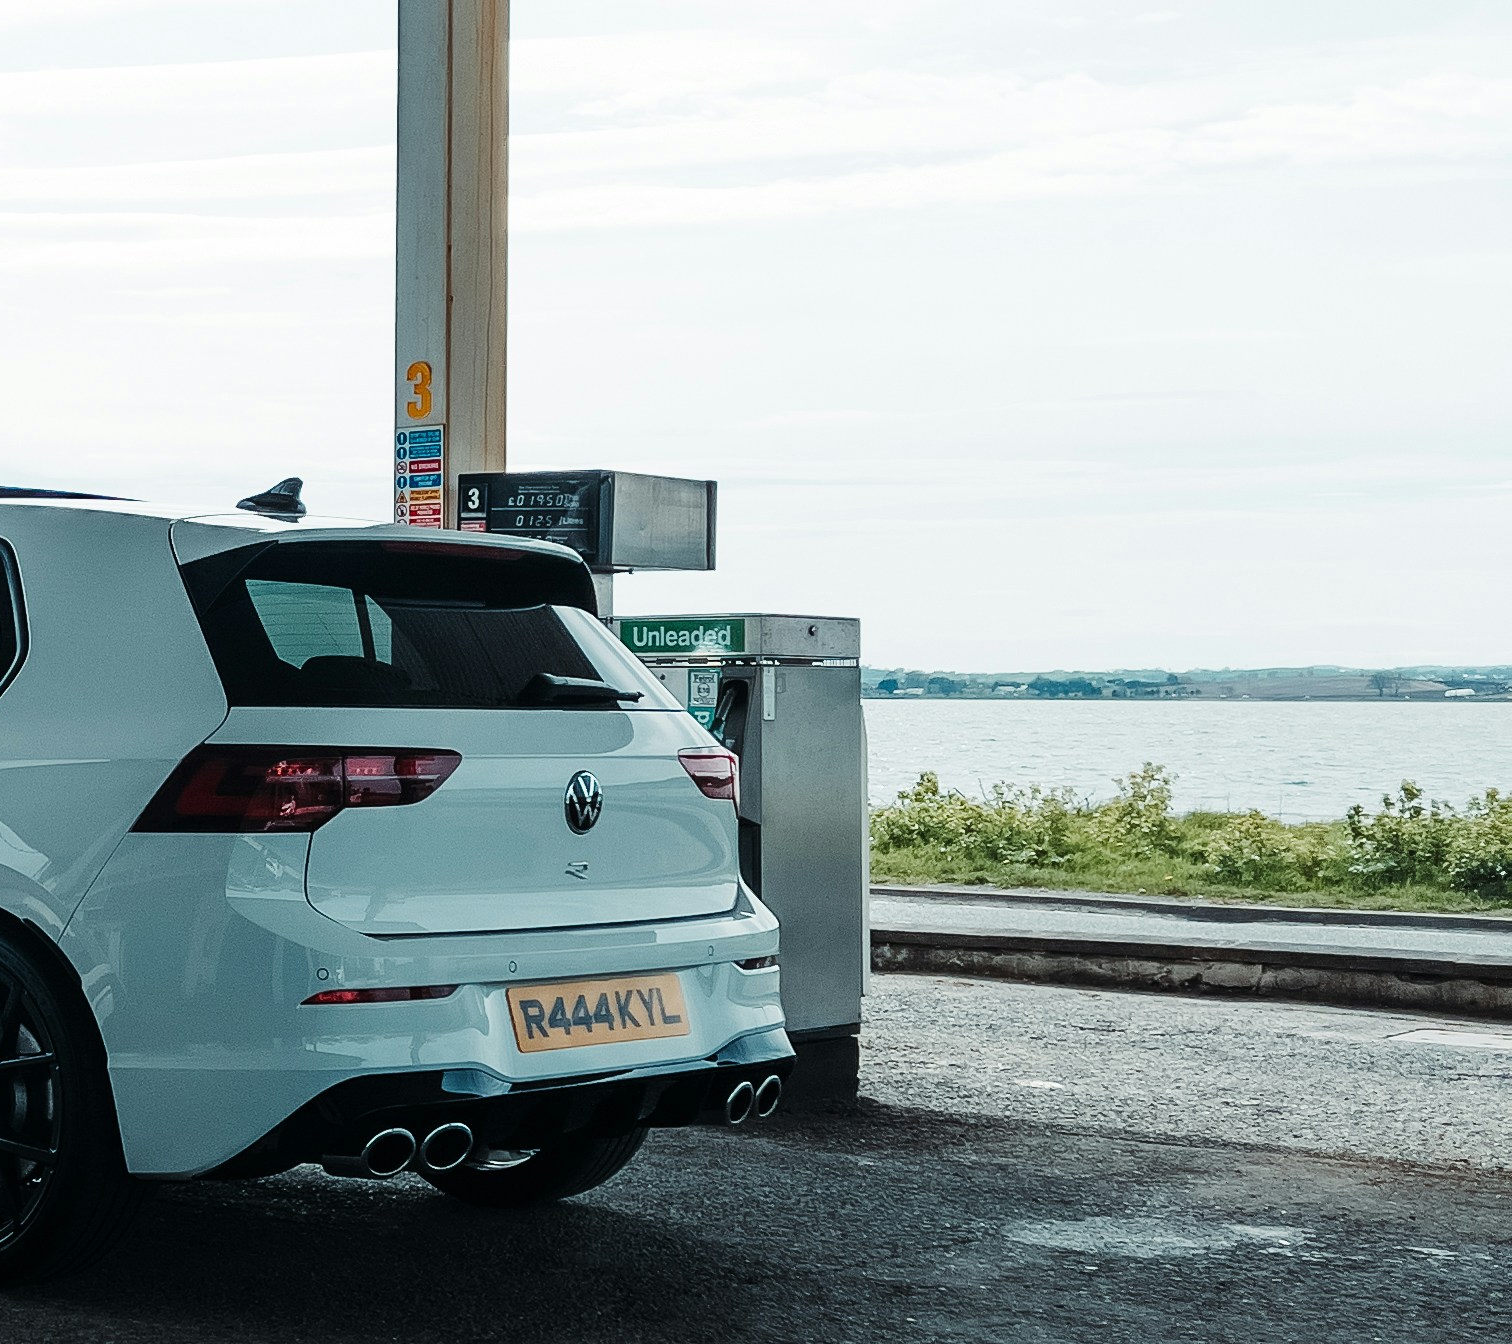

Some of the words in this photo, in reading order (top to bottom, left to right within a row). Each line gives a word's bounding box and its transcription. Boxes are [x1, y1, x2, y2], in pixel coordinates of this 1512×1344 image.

[407, 361, 432, 420] 3
[468, 488, 480, 509] 3
[633, 625, 731, 646] Unleaded
[519, 988, 681, 1039] R444KYL
